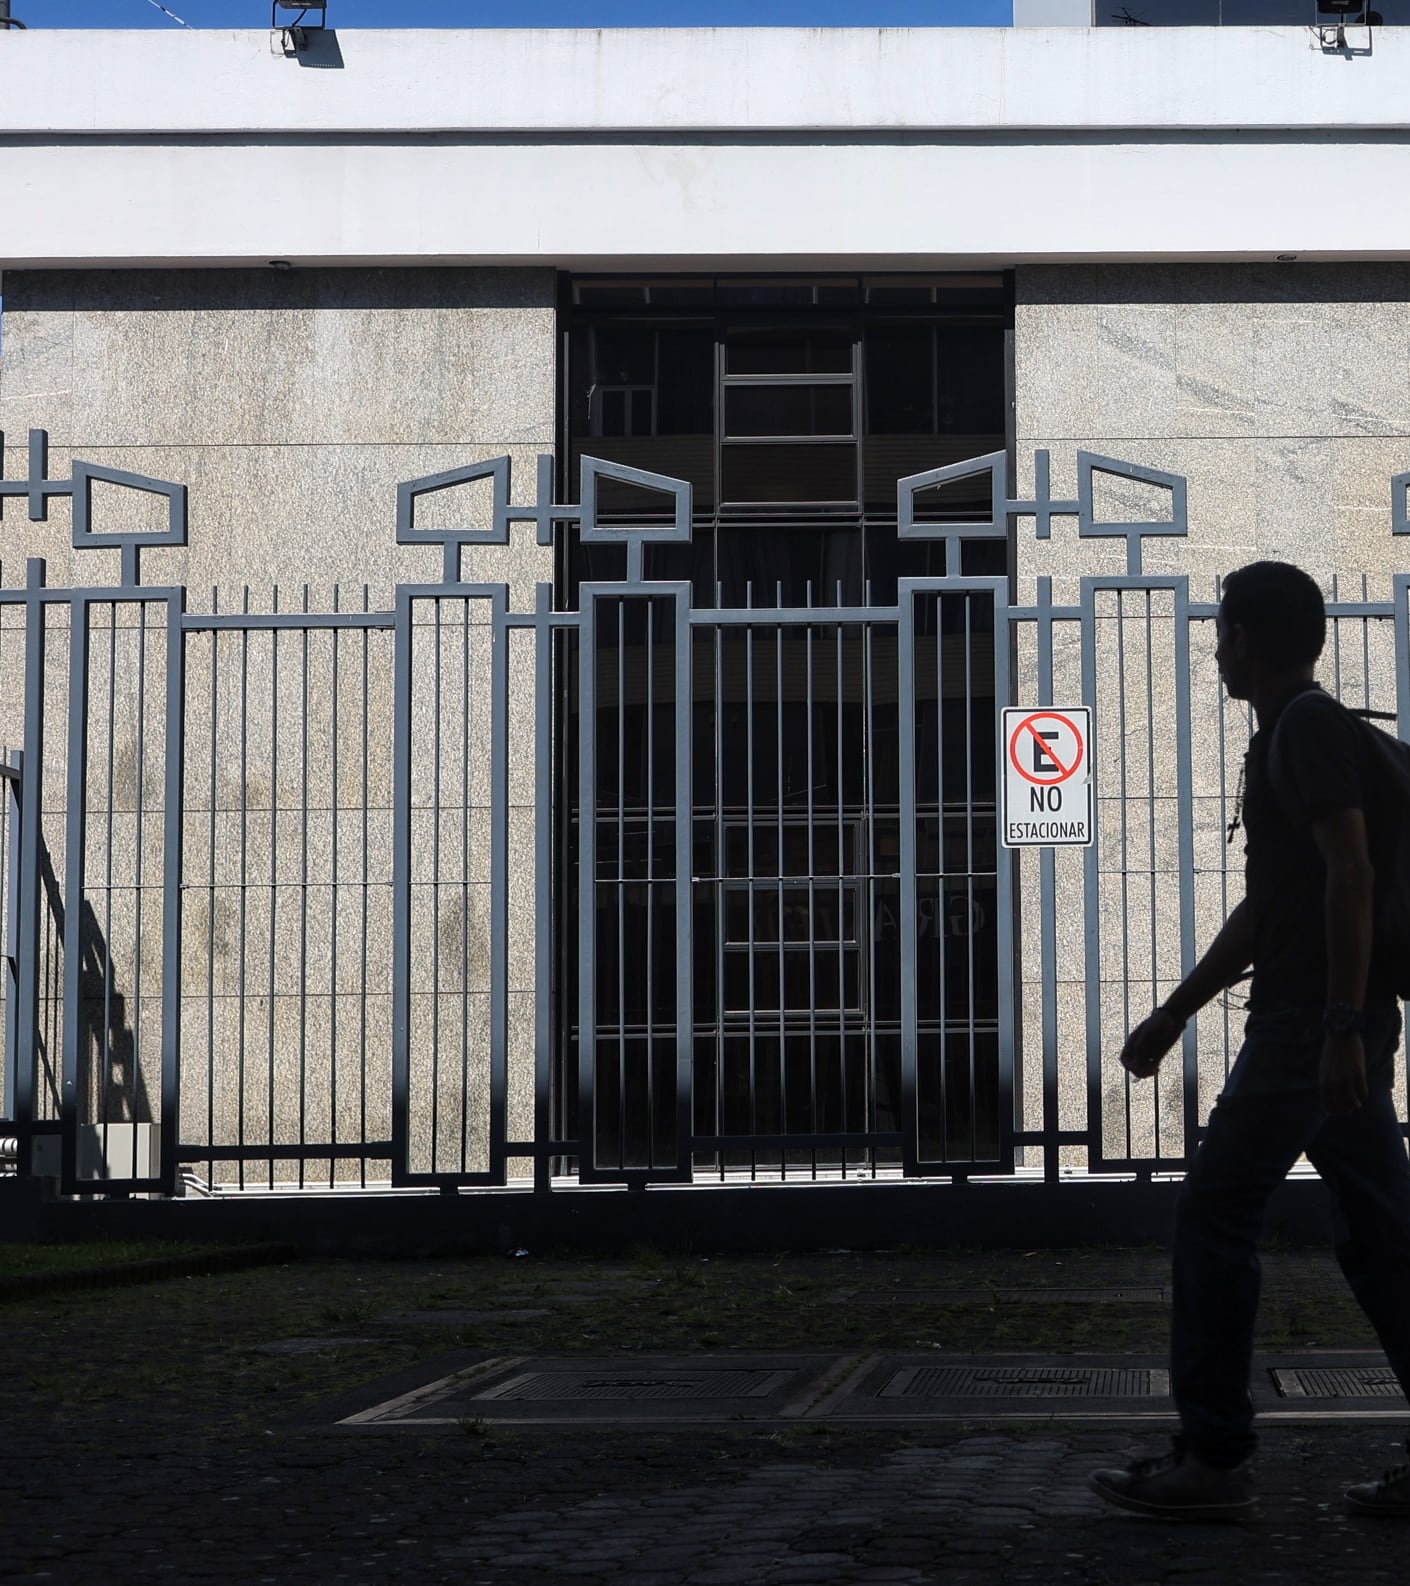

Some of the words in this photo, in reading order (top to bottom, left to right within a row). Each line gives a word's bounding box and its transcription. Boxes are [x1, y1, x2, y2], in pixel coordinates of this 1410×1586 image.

[1034, 732, 1059, 772] E
[1031, 786, 1062, 812] NO
[1010, 822, 1085, 838] ESTACIONAR
